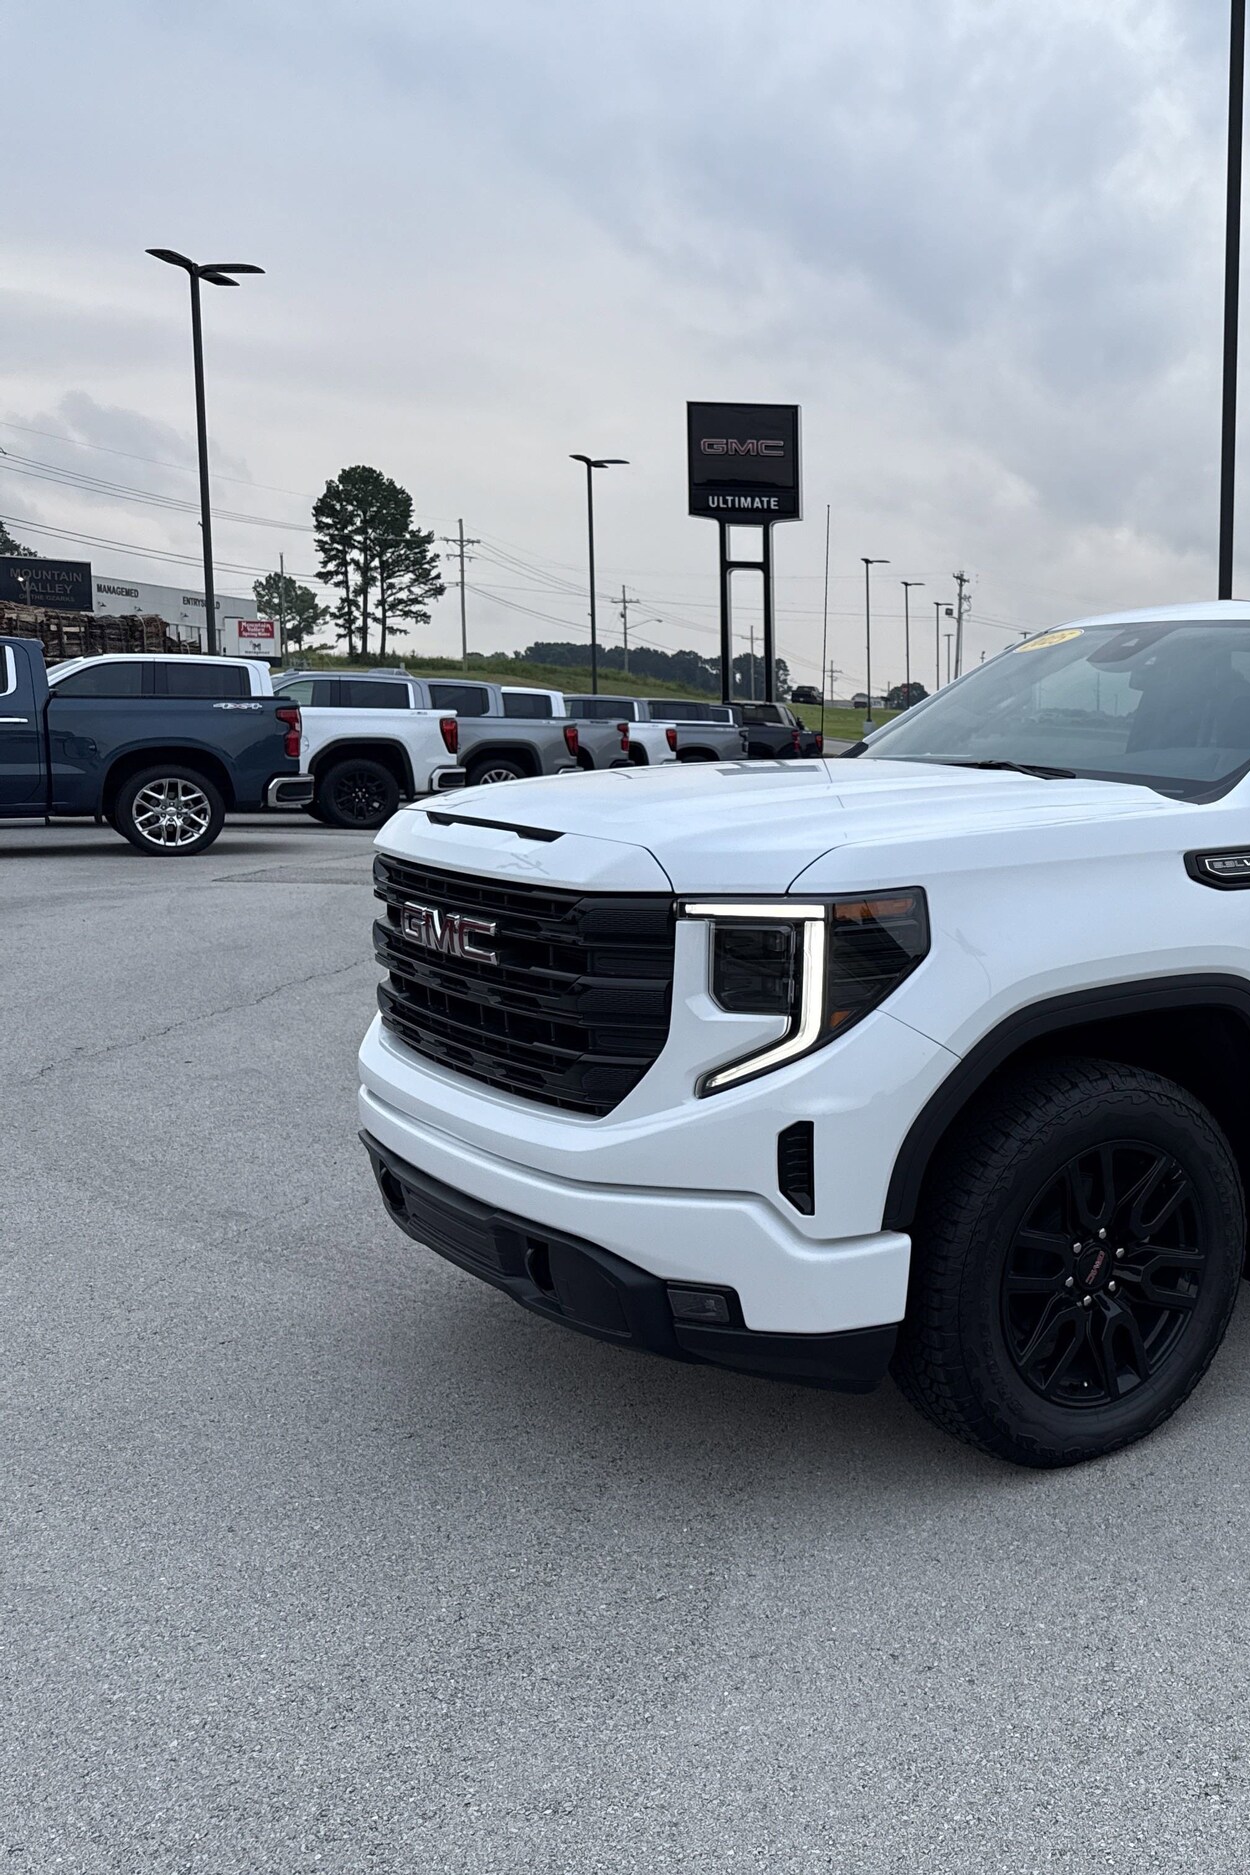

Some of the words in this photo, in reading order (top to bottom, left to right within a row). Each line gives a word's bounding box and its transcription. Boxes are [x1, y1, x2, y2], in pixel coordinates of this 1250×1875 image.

[701, 438, 784, 457] GMC
[708, 496, 779, 509] ULTIMATE
[9, 567, 82, 582] MOUNTAIN
[20, 582, 73, 594] VALLEY
[96, 584, 139, 598] MANAGEMED
[402, 901, 498, 966] GMC
[1085, 1250, 1106, 1285] GMC
